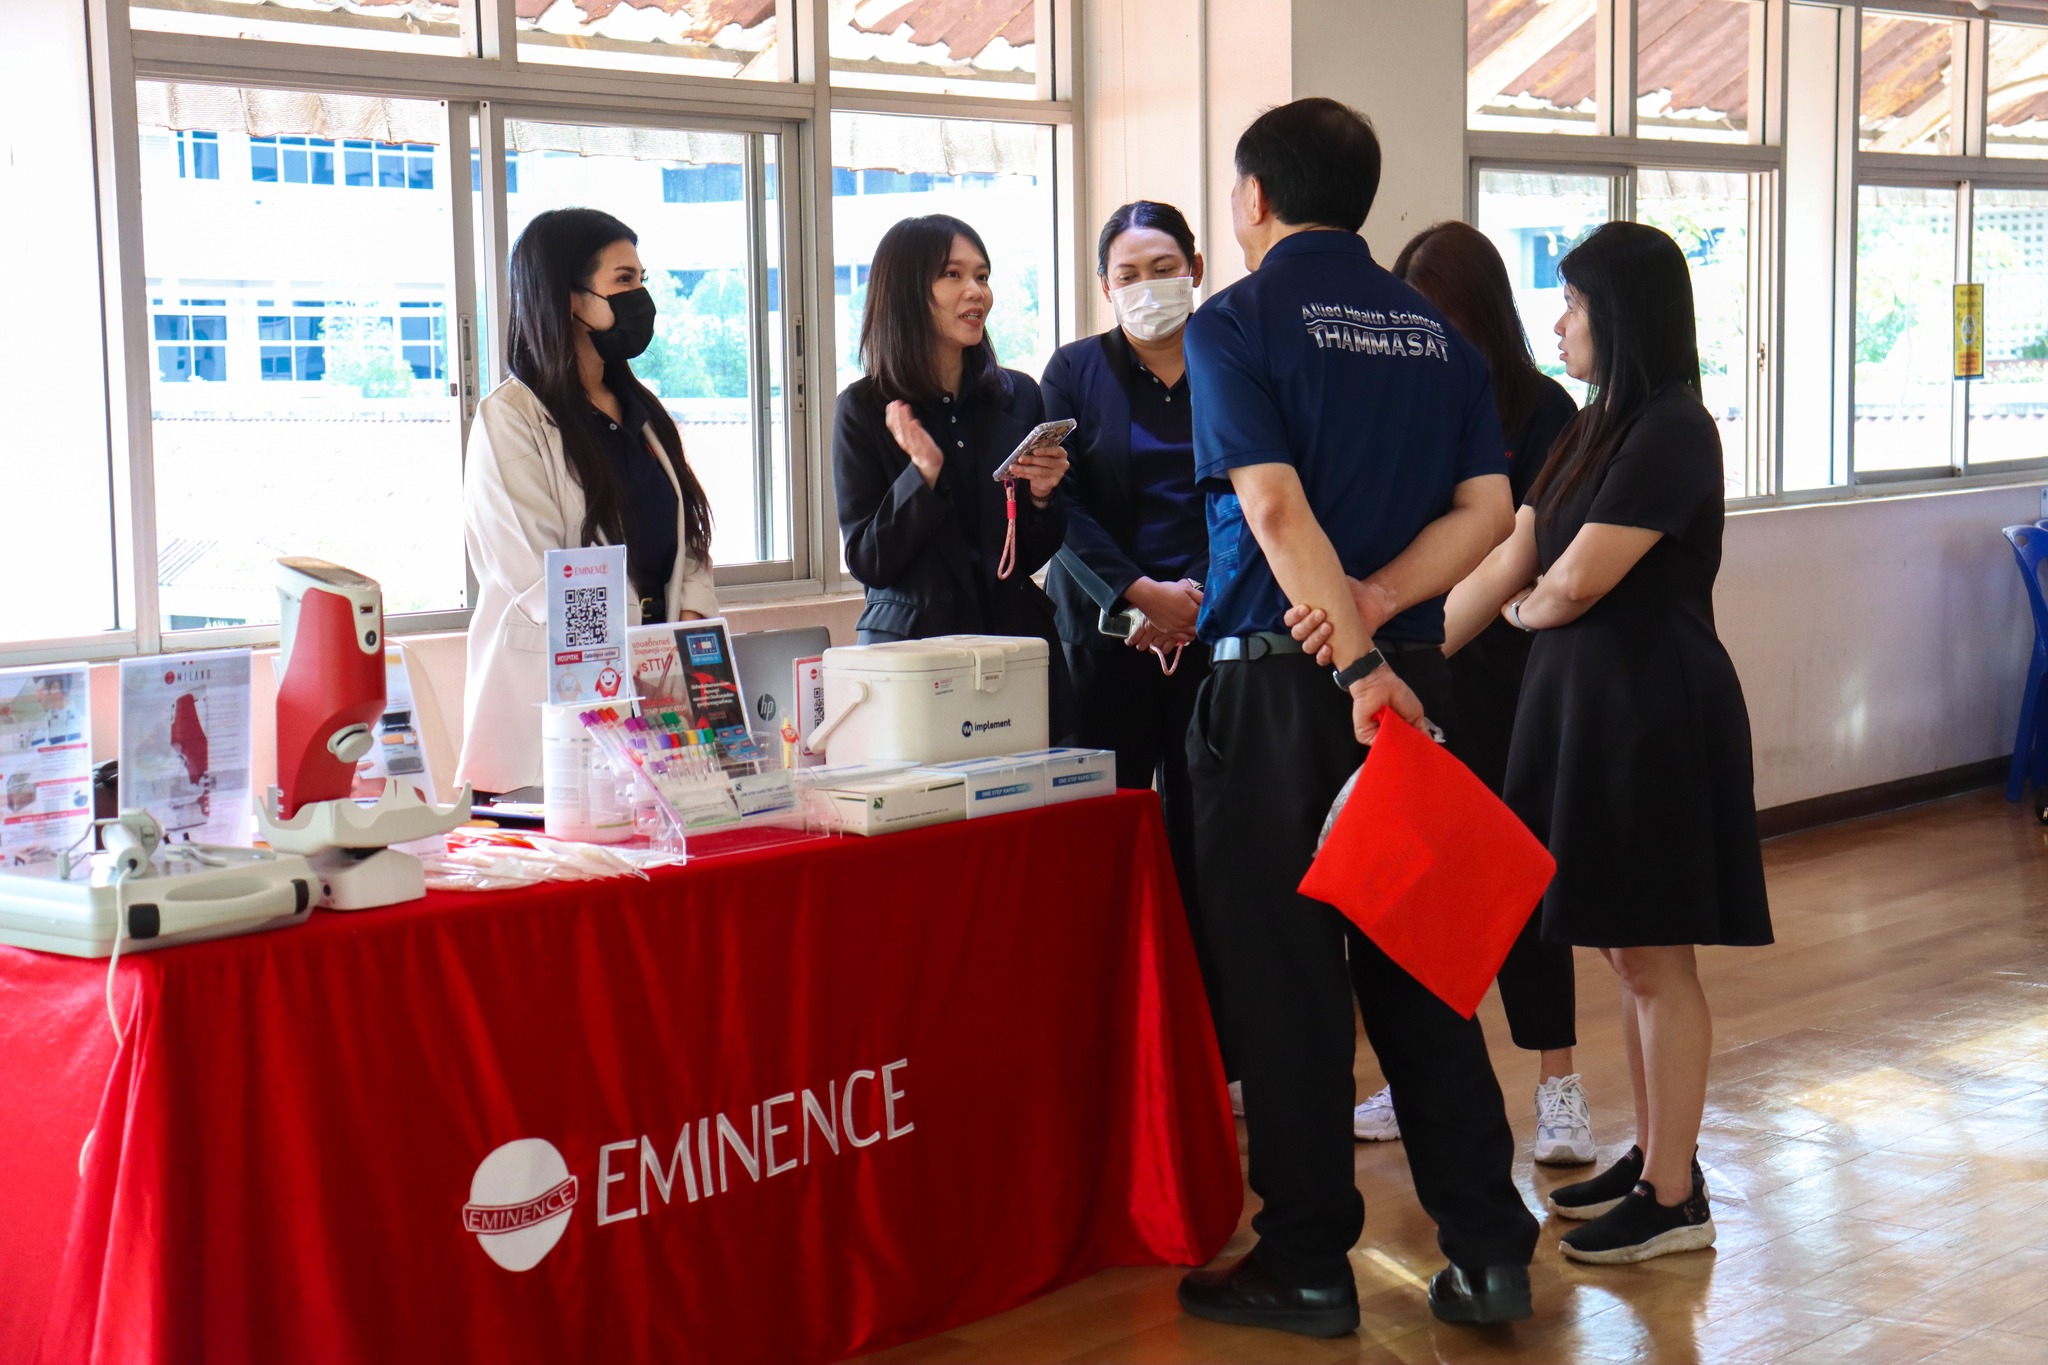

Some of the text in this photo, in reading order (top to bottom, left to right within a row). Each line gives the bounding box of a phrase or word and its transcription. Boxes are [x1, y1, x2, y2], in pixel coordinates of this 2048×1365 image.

[1301, 302, 1444, 334] Allied Health Sciences
[1307, 324, 1449, 362] THAMMASAT
[574, 564, 608, 576] EMINENCE
[557, 653, 580, 663] HOSPITAL
[177, 669, 211, 683] MILANO
[760, 693, 774, 721] hp
[974, 718, 1011, 733] implement
[981, 790, 991, 798] ONE
[991, 788, 1002, 796] STEP
[597, 1058, 915, 1227] EMINENCE
[468, 1186, 573, 1229] EMINENCE
